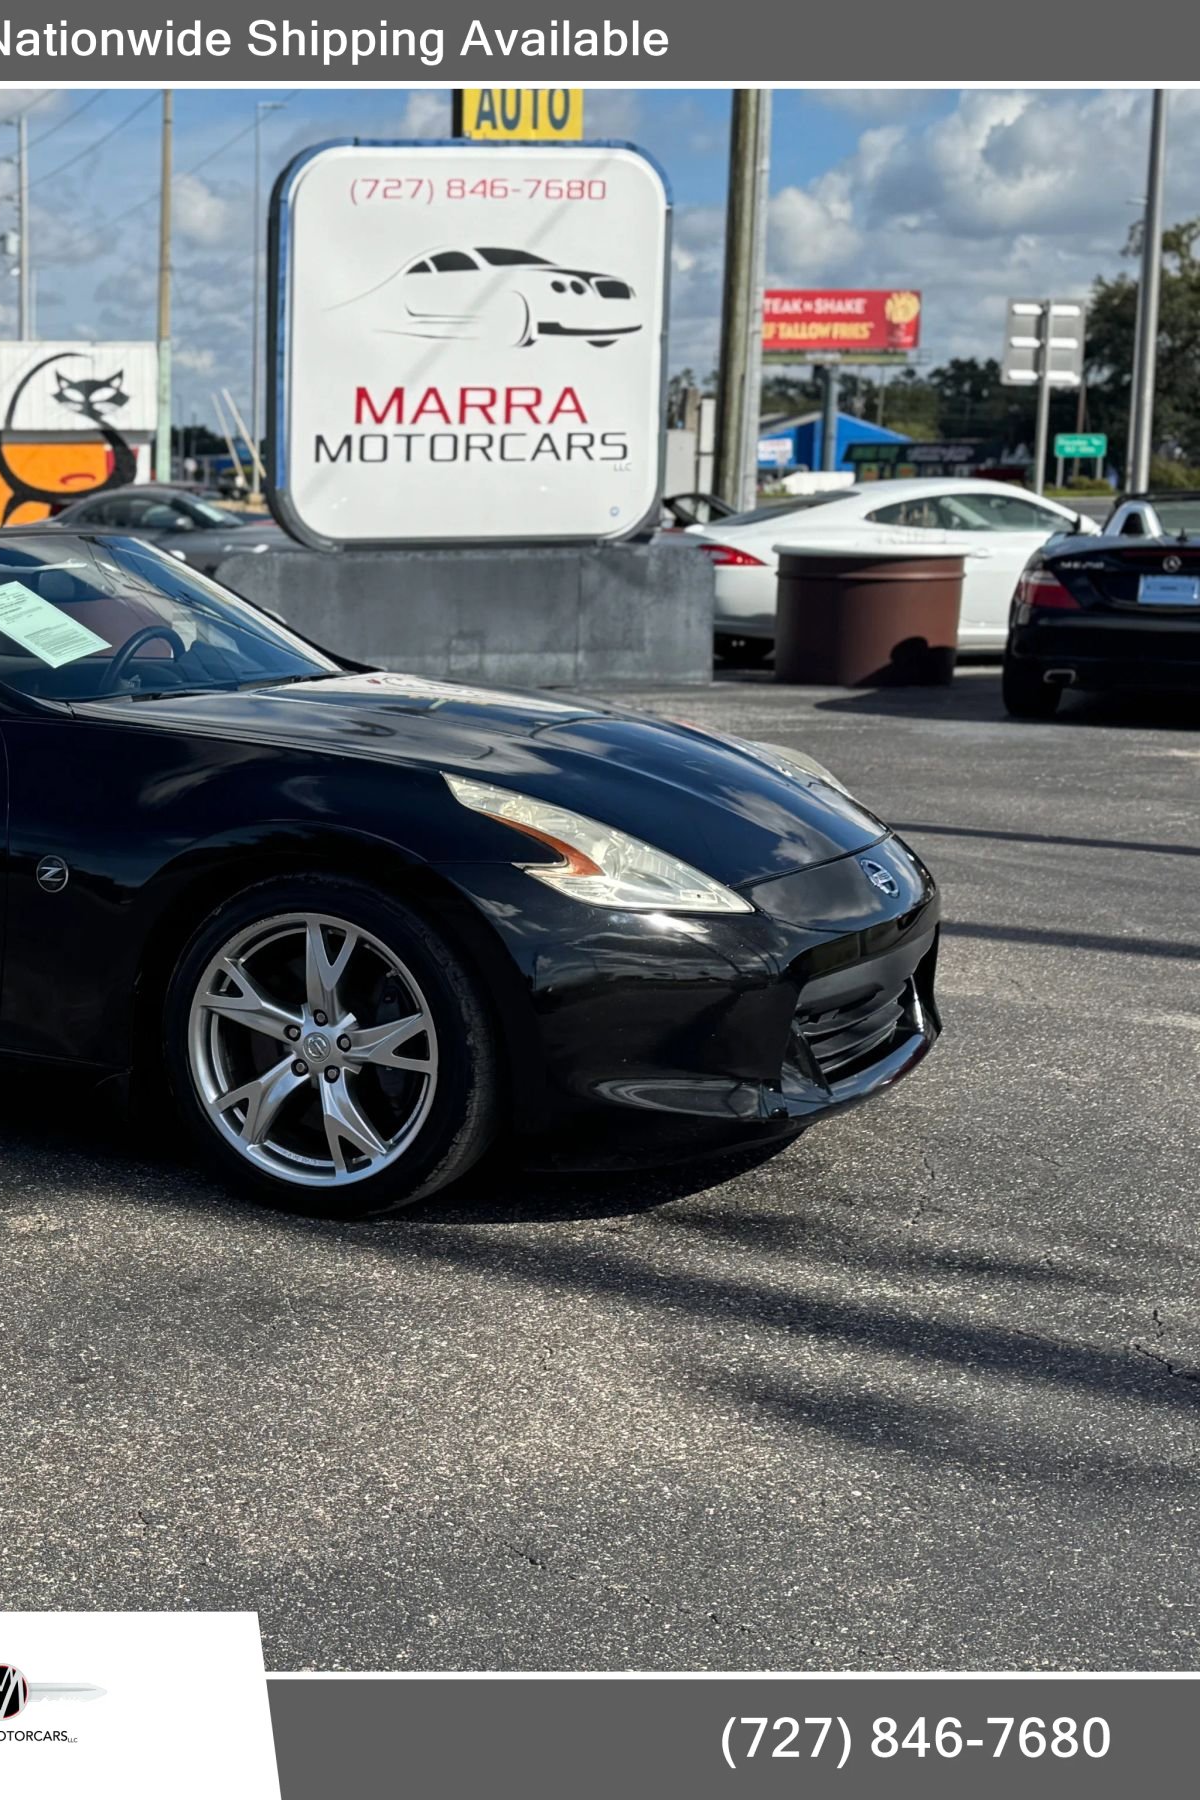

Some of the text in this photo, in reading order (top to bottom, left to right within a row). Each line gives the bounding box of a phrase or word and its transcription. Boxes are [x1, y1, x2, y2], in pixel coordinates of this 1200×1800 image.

[475, 89, 571, 131] AUTO
[350, 178, 607, 205] (727) 846-7680
[764, 298, 802, 315] TEAK
[354, 385, 589, 425] MARRA
[314, 432, 632, 472] MOTORCARS LLC
